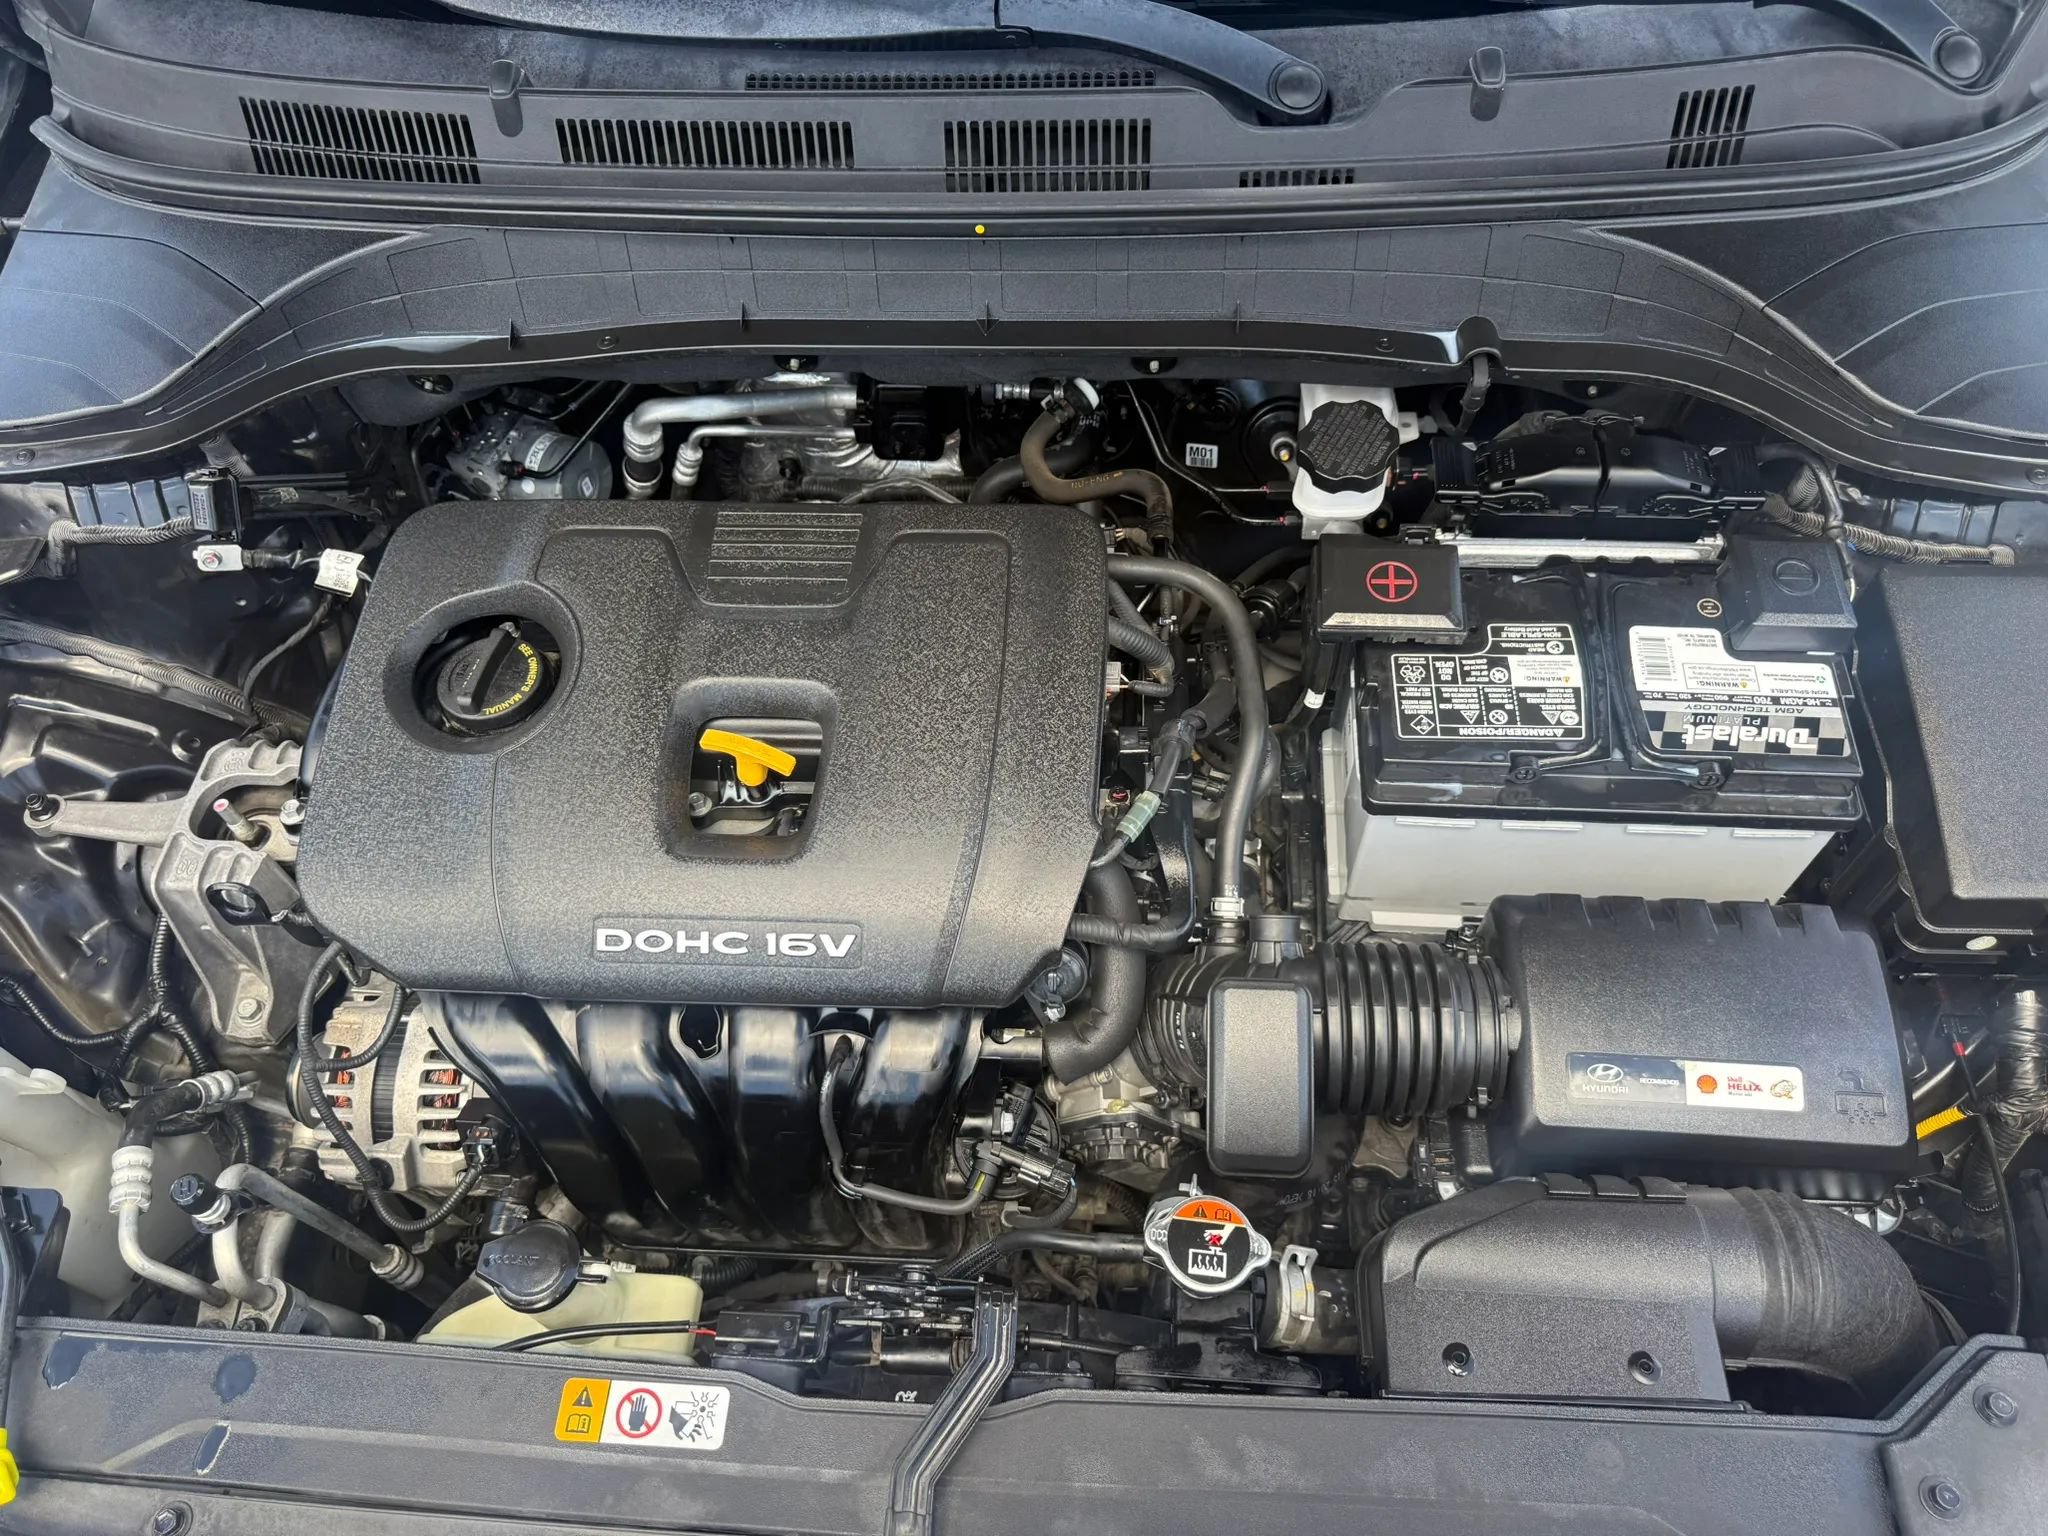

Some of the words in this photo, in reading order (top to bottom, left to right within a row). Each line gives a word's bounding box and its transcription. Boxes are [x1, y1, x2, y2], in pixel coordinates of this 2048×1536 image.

[1188, 446, 1213, 458] M01
[518, 643, 534, 657] SEE
[520, 656, 538, 692] OWNER'S
[481, 692, 522, 715] MANUAL
[1684, 704, 1770, 713] TECHNOLOGY
[1683, 715, 1761, 725] PLATINUM
[1459, 728, 1554, 736] DANGER/POISON
[1682, 724, 1817, 749] Duralast
[596, 928, 750, 955] DOHC
[766, 932, 857, 958] 16V
[1582, 1084, 1629, 1094] HYUNDAI
[1728, 1082, 1763, 1091] HELIX
